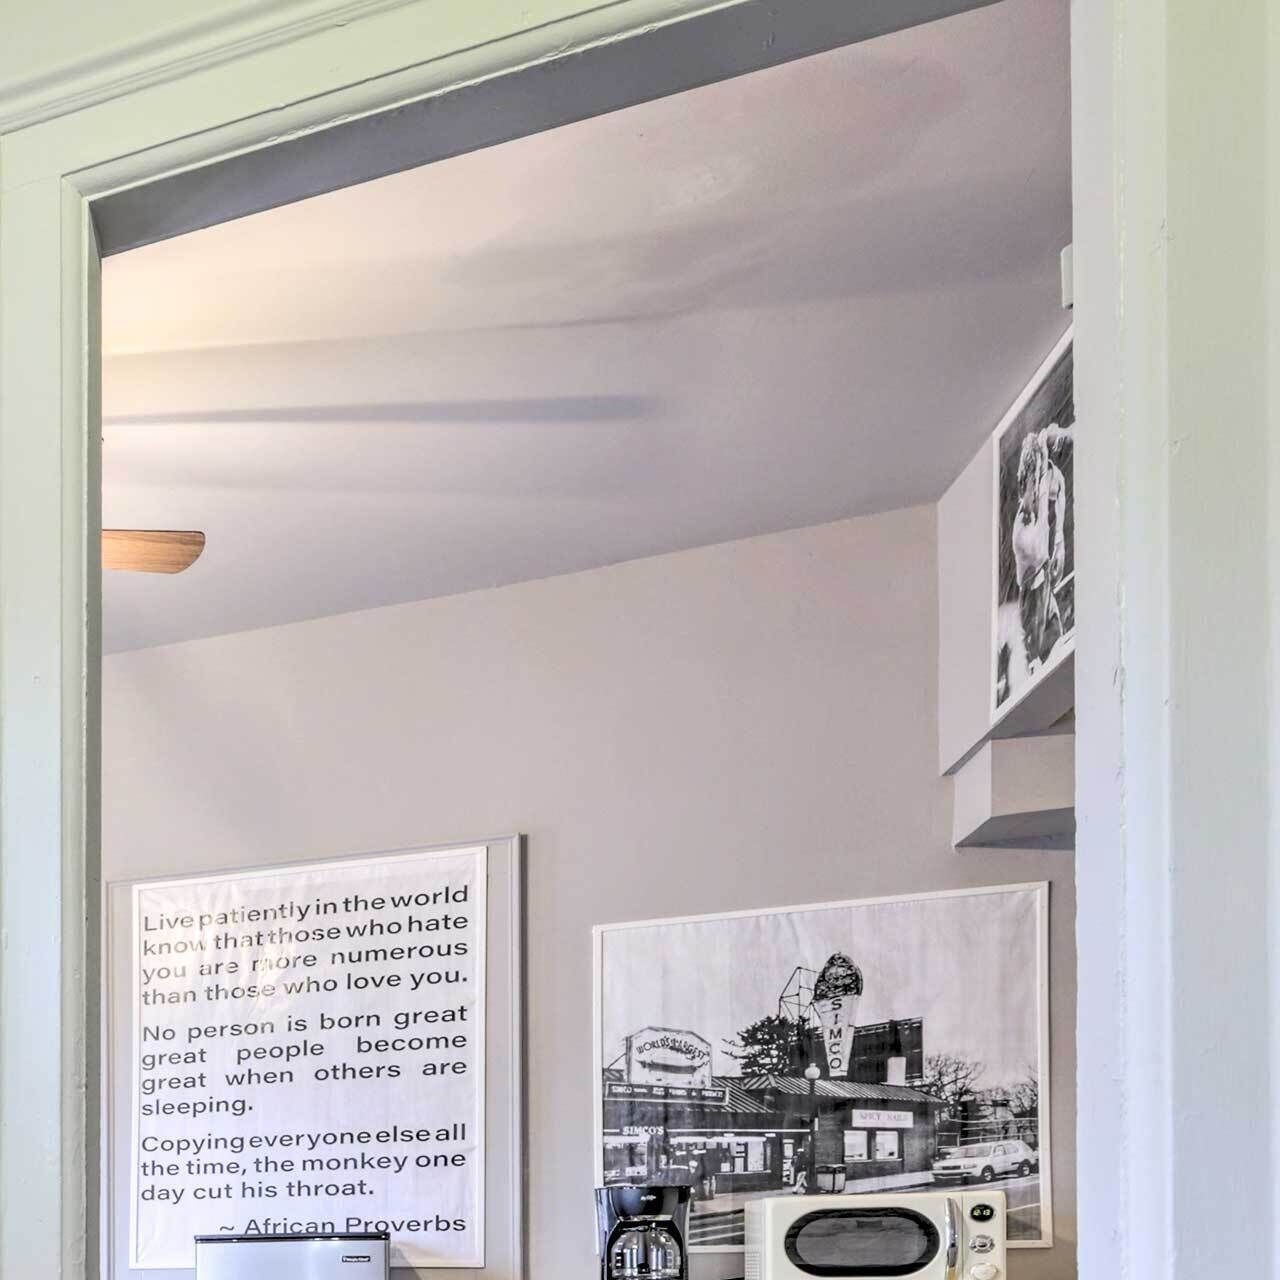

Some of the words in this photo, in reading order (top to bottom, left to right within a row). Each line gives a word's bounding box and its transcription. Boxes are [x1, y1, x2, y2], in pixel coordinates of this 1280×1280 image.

[143, 914, 194, 932] Live
[199, 901, 310, 930] patiently
[316, 899, 337, 915] in
[343, 895, 386, 913] the
[390, 885, 469, 909] world
[143, 939, 206, 957] know
[214, 932, 264, 950] that
[267, 927, 341, 945] those
[346, 920, 402, 938] who
[408, 914, 469, 932] hate
[142, 964, 187, 985] you
[199, 961, 239, 977] are
[251, 954, 318, 973] more
[330, 942, 469, 964] numerous
[142, 989, 197, 1006] than
[205, 982, 276, 1002] those
[283, 976, 338, 995] who
[346, 972, 402, 991] love
[410, 970, 468, 991] you.
[142, 1025, 176, 1042] No
[188, 1022, 275, 1044] person
[287, 1015, 308, 1033] is
[320, 1012, 381, 1031] born
[393, 1005, 468, 1030] great
[828, 998, 843, 1070] SIMCO
[141, 1048, 207, 1071] great
[236, 1039, 325, 1065] people
[356, 1034, 468, 1054] become
[141, 1072, 207, 1095] great
[225, 1067, 294, 1087] when
[314, 1063, 402, 1082] others
[422, 1061, 468, 1077] are
[141, 1096, 254, 1118] sleeping.
[141, 1132, 245, 1155] Copying
[249, 1129, 372, 1150] everyone
[375, 1125, 431, 1143] else
[435, 1123, 467, 1142] all
[140, 1160, 180, 1176] the
[186, 1158, 248, 1177] time,
[254, 1156, 295, 1173] the
[302, 1152, 409, 1174] monkey
[414, 1154, 467, 1169] one
[141, 1184, 185, 1205] day
[192, 1183, 233, 1200] cut
[241, 1181, 278, 1198] his
[285, 1179, 375, 1197] throat.
[243, 1217, 336, 1235] African
[345, 1214, 467, 1235] Proverbs
